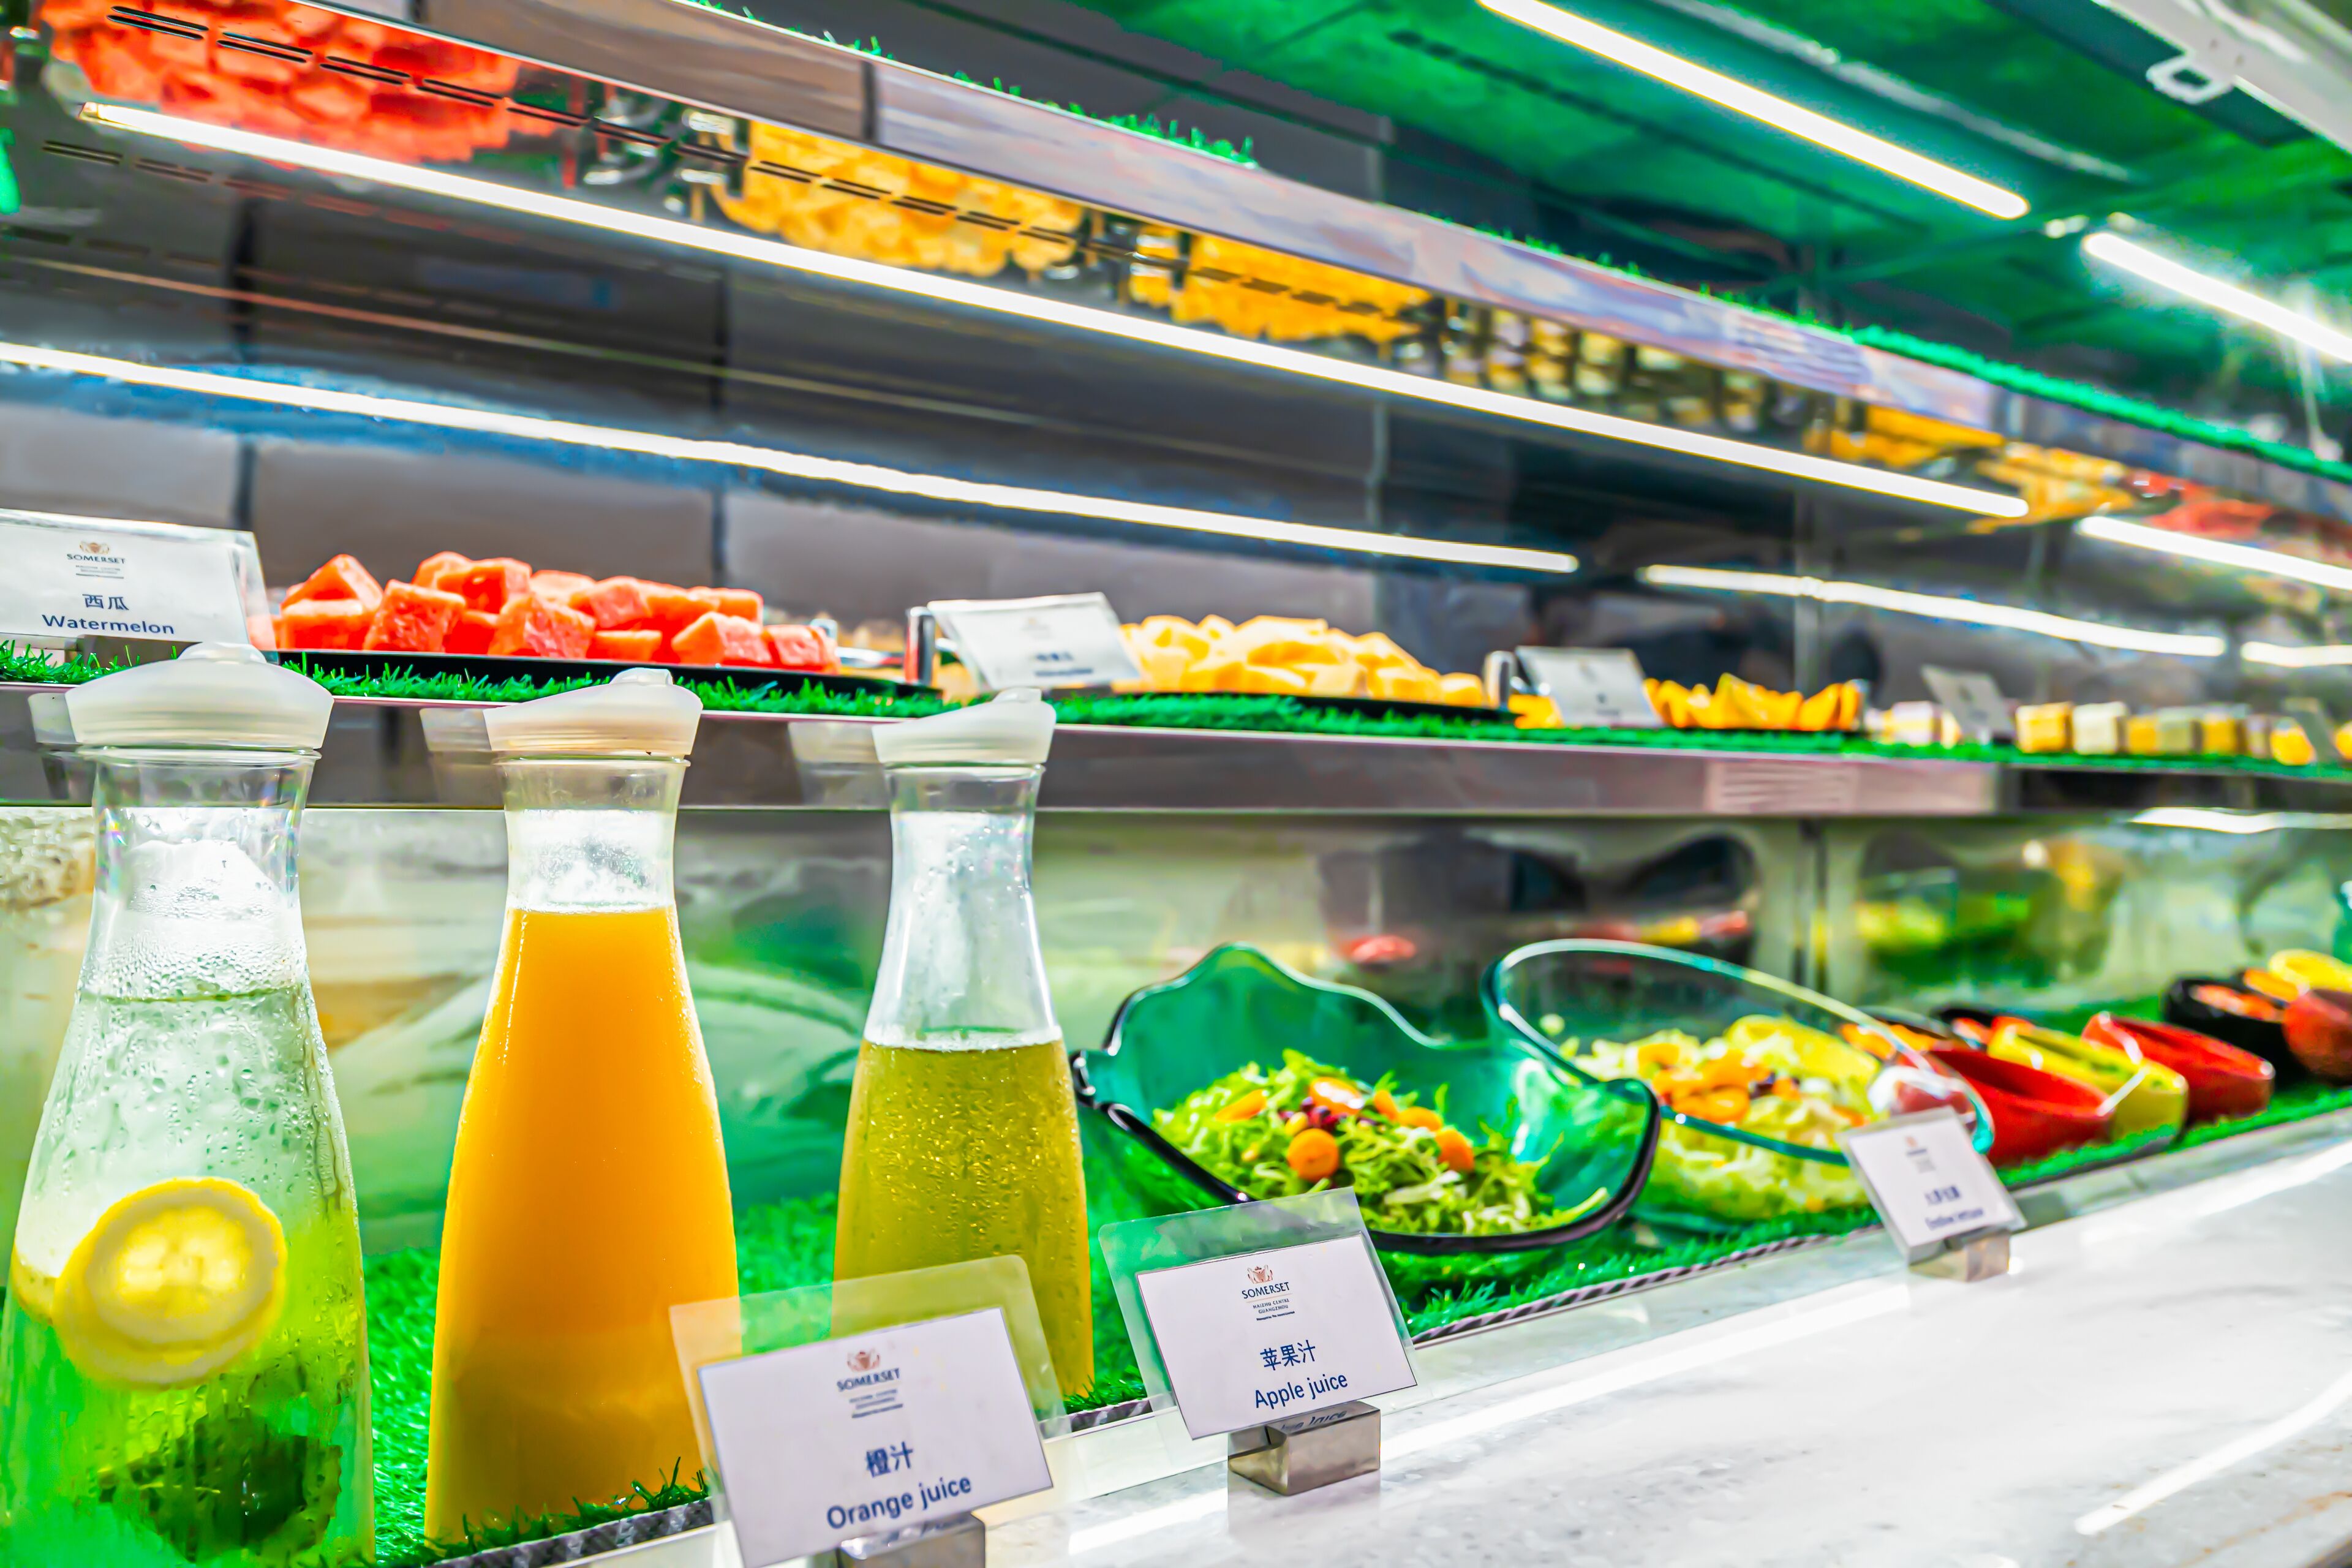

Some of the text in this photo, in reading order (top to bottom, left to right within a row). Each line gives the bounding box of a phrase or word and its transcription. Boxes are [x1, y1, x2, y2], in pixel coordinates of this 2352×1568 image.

[67, 553, 126, 564] SOMERSET
[82, 593, 129, 610] 西瓜
[42, 614, 175, 635] Watermelon
[1242, 1281, 1290, 1299] SOMERSET
[1258, 1304, 1289, 1314] GUANGZHOU
[1260, 1340, 1316, 1371] 苹果汁
[836, 1367, 900, 1392] SOMERSET
[1255, 1373, 1348, 1410] Apple juice
[826, 1492, 914, 1529] Orange
[918, 1476, 972, 1510] juice
